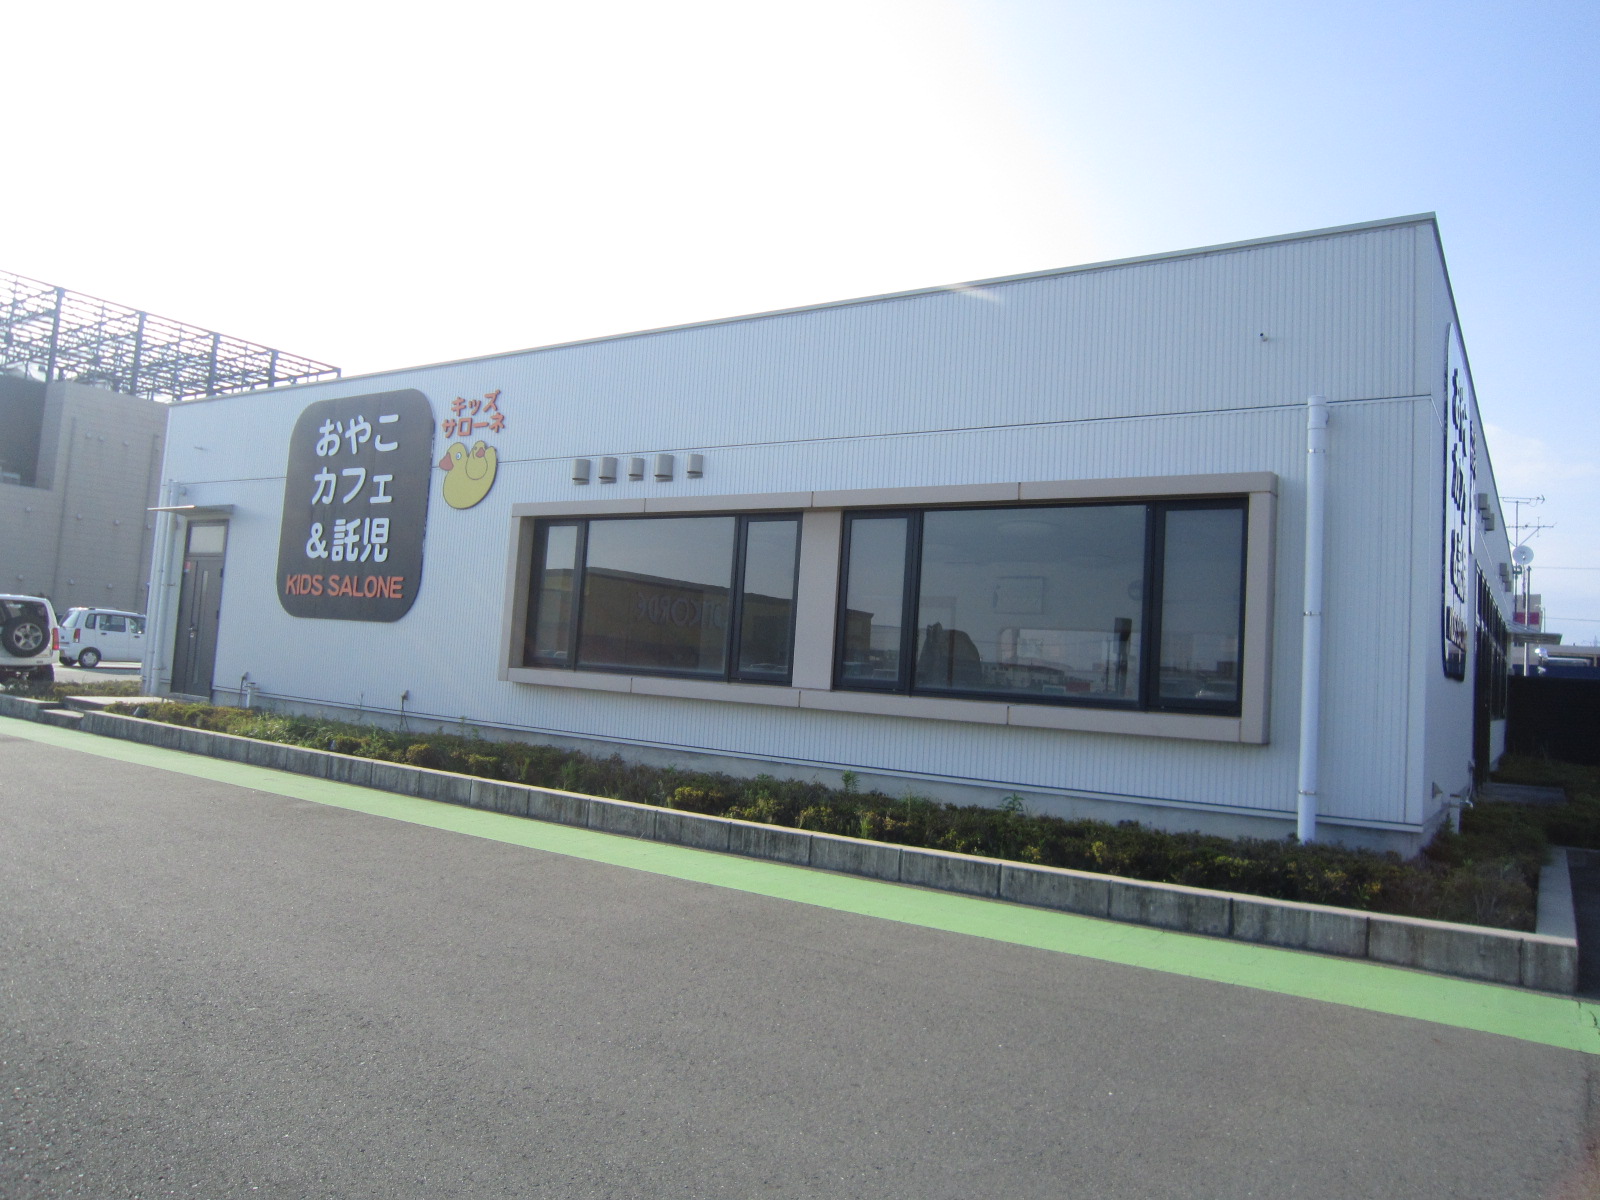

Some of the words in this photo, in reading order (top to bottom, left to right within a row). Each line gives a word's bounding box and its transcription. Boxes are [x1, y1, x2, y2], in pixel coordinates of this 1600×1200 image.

[451, 389, 501, 417] キッズ
[316, 414, 400, 457] おやこ
[442, 413, 506, 438] サローネ
[311, 467, 394, 505] カフェ
[305, 517, 390, 563] &託児
[285, 574, 324, 596] KIDS
[327, 574, 404, 599] SALONE
